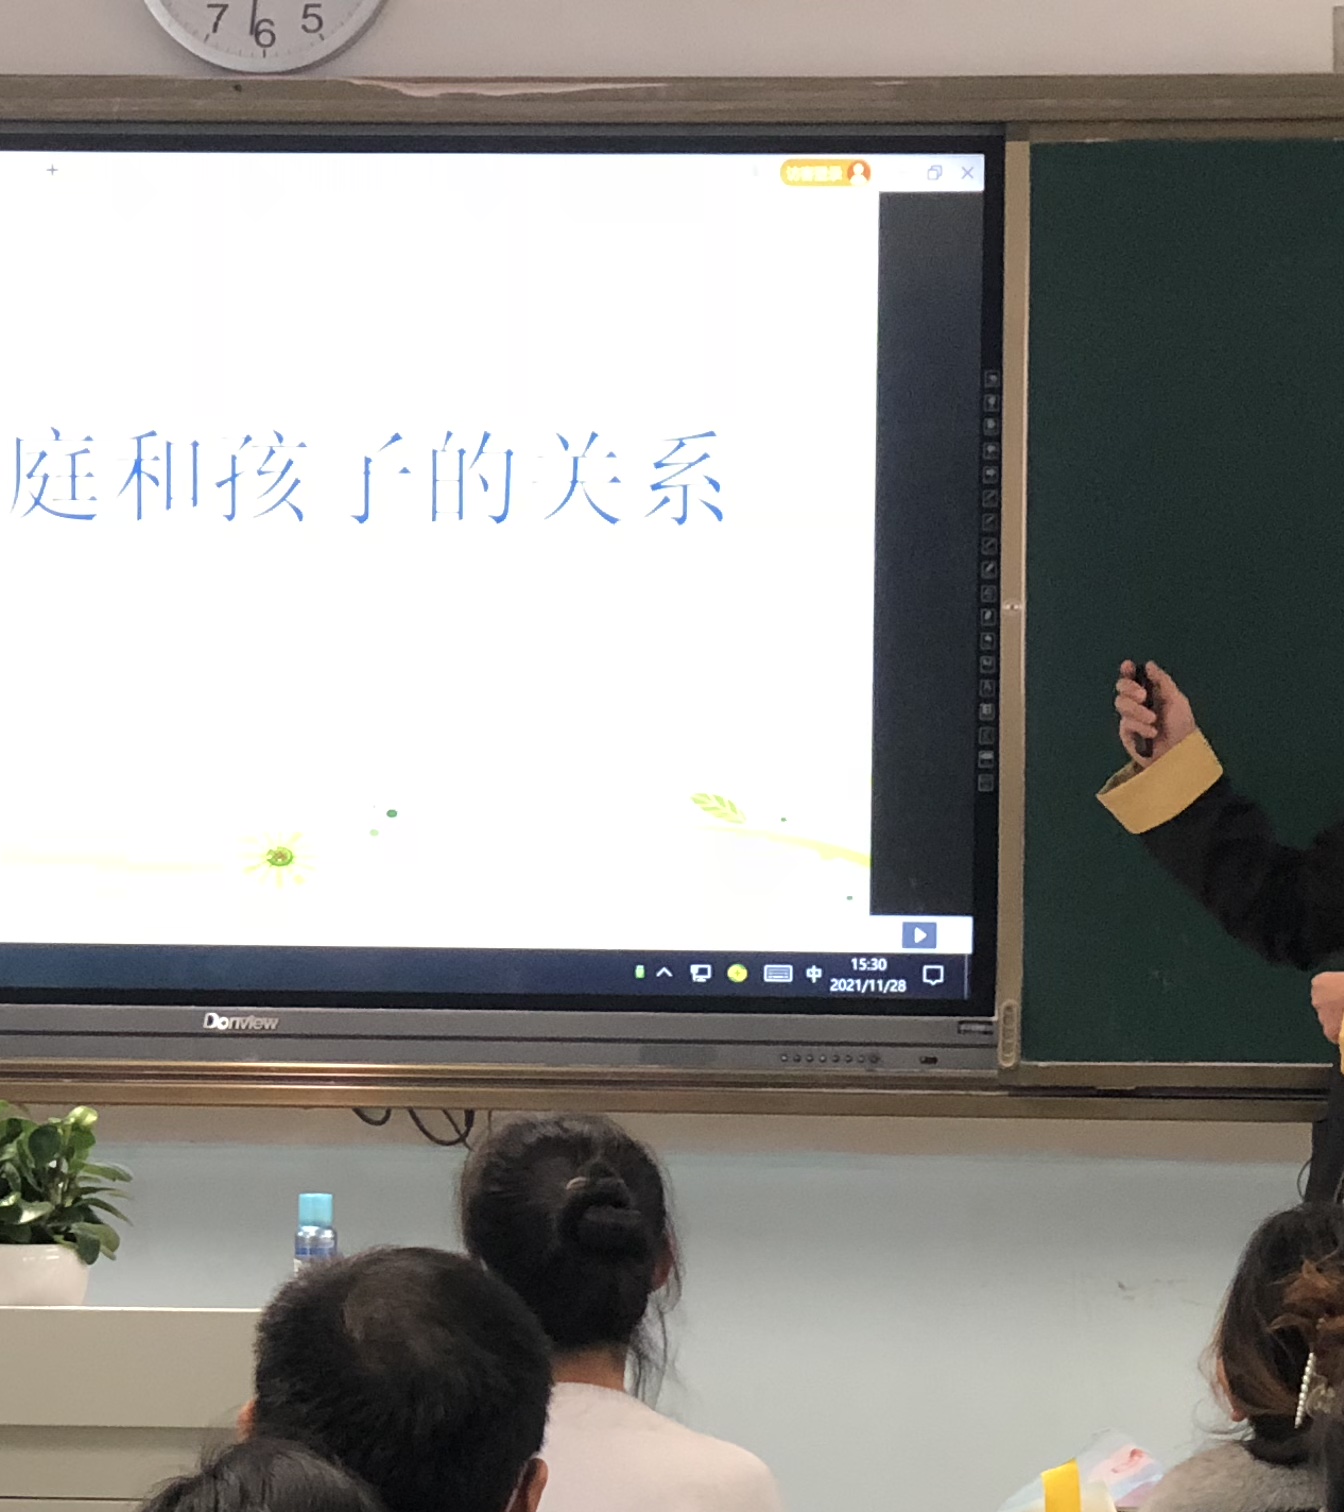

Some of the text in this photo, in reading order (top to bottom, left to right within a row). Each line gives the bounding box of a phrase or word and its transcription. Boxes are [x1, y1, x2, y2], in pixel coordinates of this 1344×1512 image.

[207, 4, 229, 34] 7
[301, 4, 324, 34] 5
[255, 19, 276, 48] 6
[806, 964, 822, 983] 中
[851, 957, 887, 972] 15:30
[829, 977, 907, 994] 2021/11/28
[203, 1012, 279, 1030] Donview
